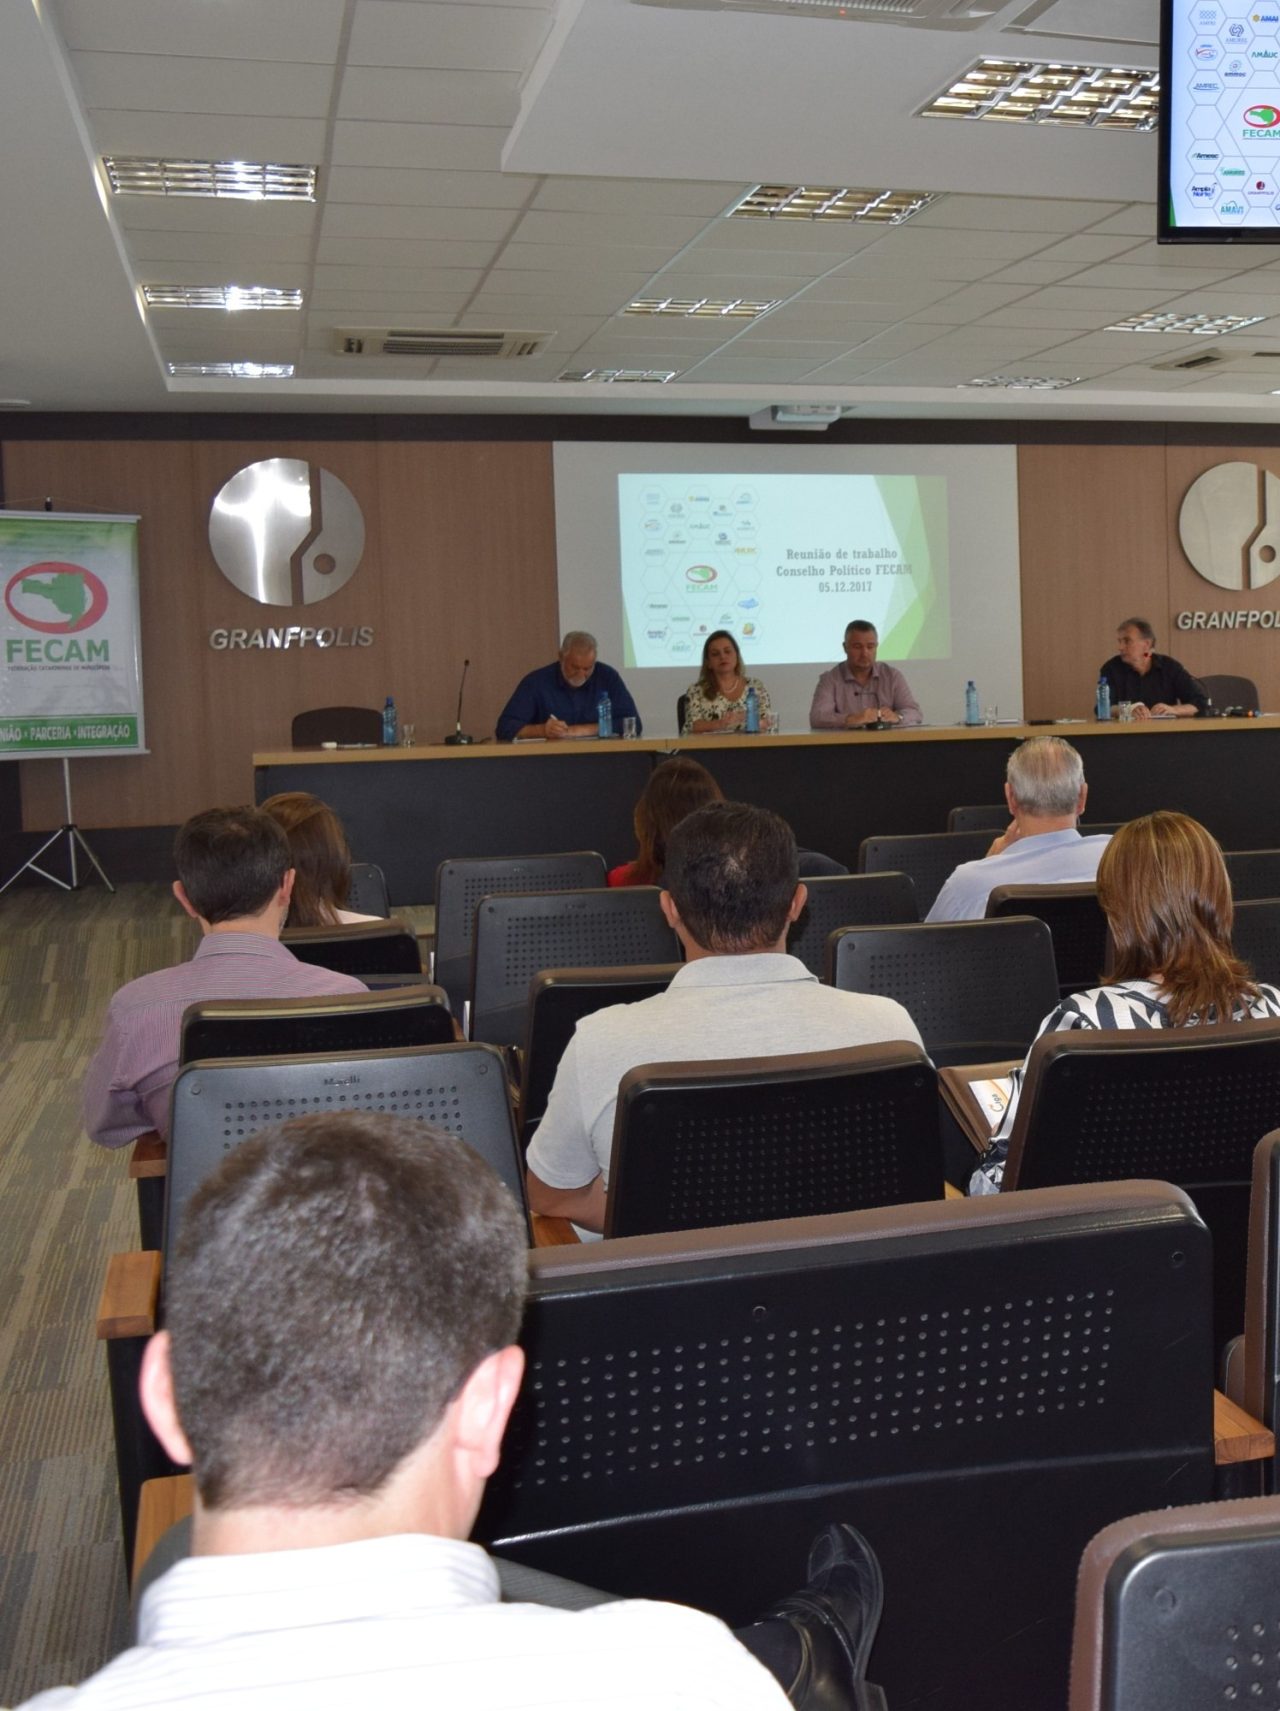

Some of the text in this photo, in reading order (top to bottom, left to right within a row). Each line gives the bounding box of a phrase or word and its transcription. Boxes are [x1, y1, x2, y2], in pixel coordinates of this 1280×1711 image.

[786, 548, 898, 560] Reunião de trabalho
[776, 563, 913, 577] Conselho Político FECAM
[818, 581, 872, 593] 05.12.2017
[208, 626, 374, 650] GRANFPOLIS
[6, 639, 109, 662] FECAM
[30, 725, 72, 741] PARCERIA
[77, 721, 130, 742] INTEGRAÇÃO
